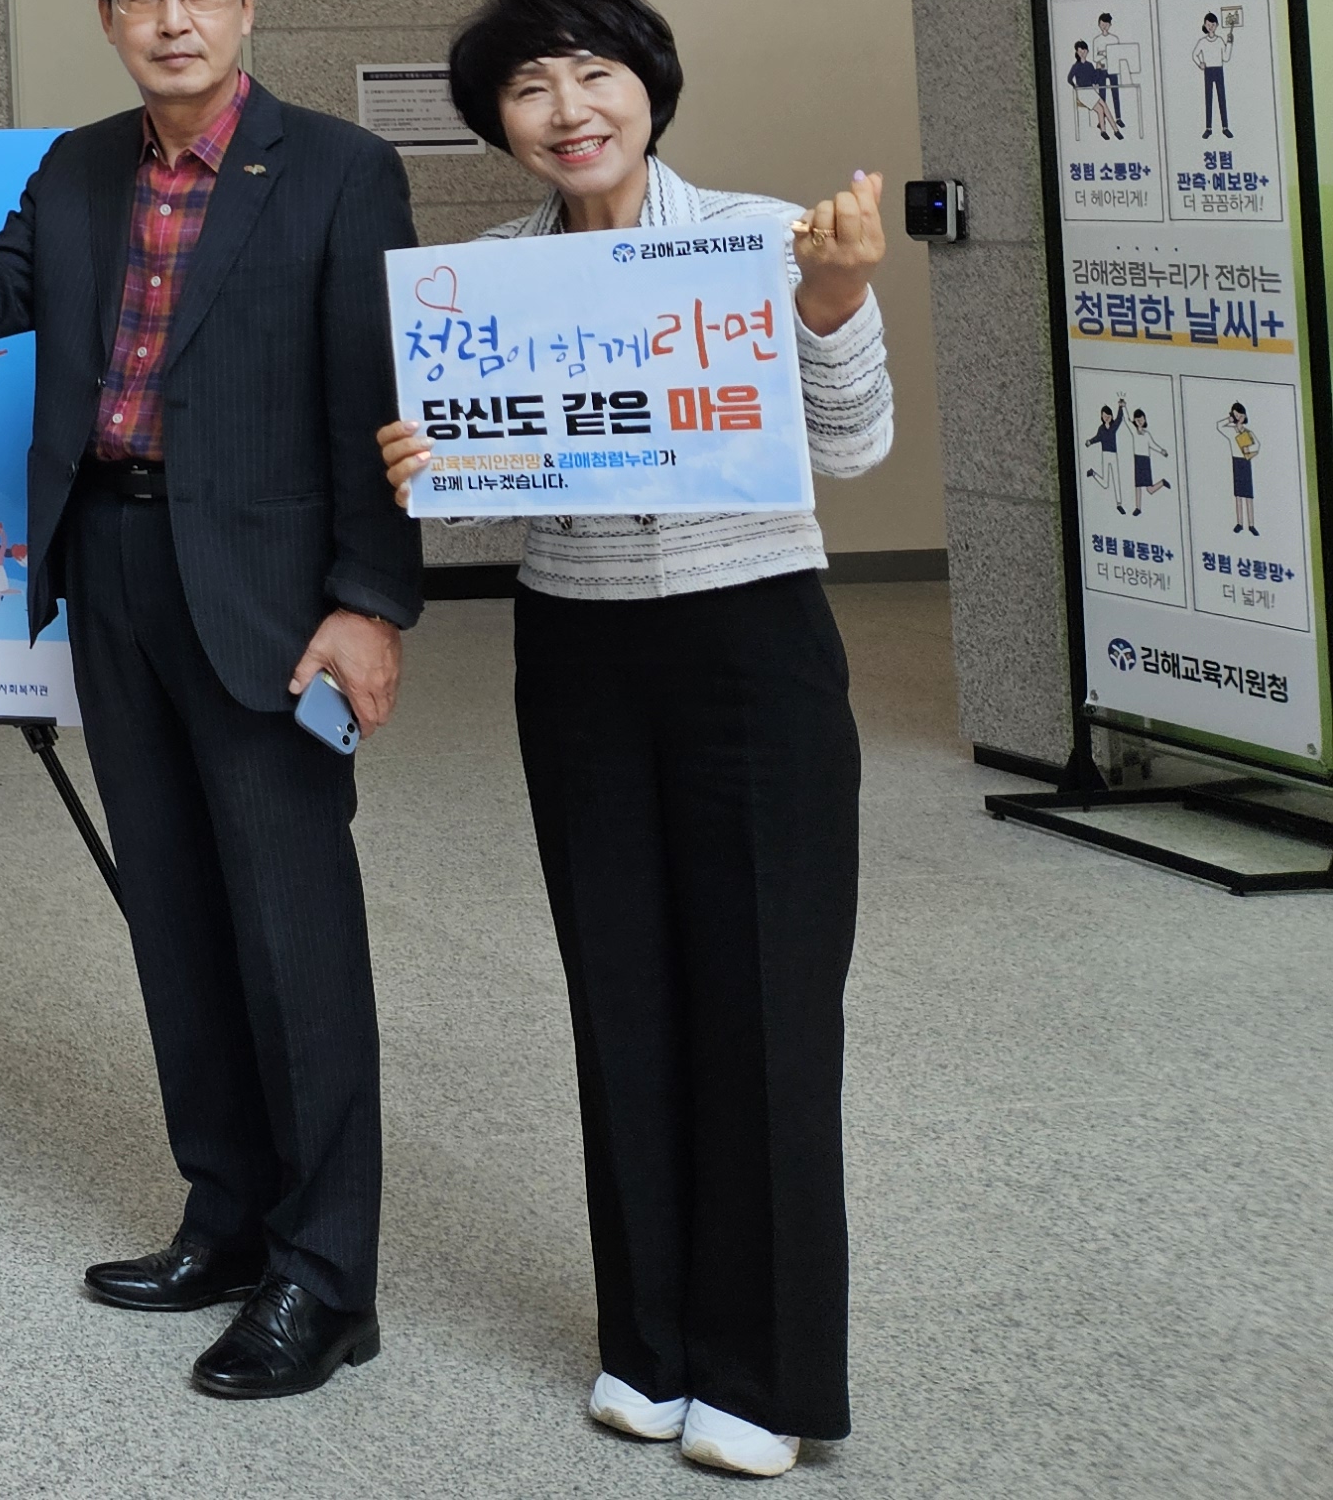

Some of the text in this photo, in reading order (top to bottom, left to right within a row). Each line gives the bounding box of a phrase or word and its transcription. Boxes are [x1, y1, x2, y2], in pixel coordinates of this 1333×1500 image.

[1069, 162, 1096, 182] 청렴
[1203, 150, 1233, 171] 청렴
[1074, 189, 1148, 208] 더 헤아리게!
[1183, 194, 1264, 214] 더 꼼꼼하게!
[640, 234, 764, 261] 김해교육지원청
[1072, 259, 1282, 294] 김해청렴누리가 전하는
[1074, 291, 1284, 348] 청렴한 날씨+
[405, 314, 535, 382] 청렴이
[422, 385, 762, 441] 당신도 같은 마음
[431, 450, 677, 472] 교육복지안전망 & 김해청렴누리가
[431, 474, 569, 491] 함께 나누겠습니다.
[1092, 534, 1118, 556] 청렴
[1202, 551, 1232, 575] 청렴
[1097, 562, 1171, 591] 더 다양하게!
[1222, 584, 1276, 610] 더 넓게!
[1141, 646, 1289, 704] 김해교육지원청
